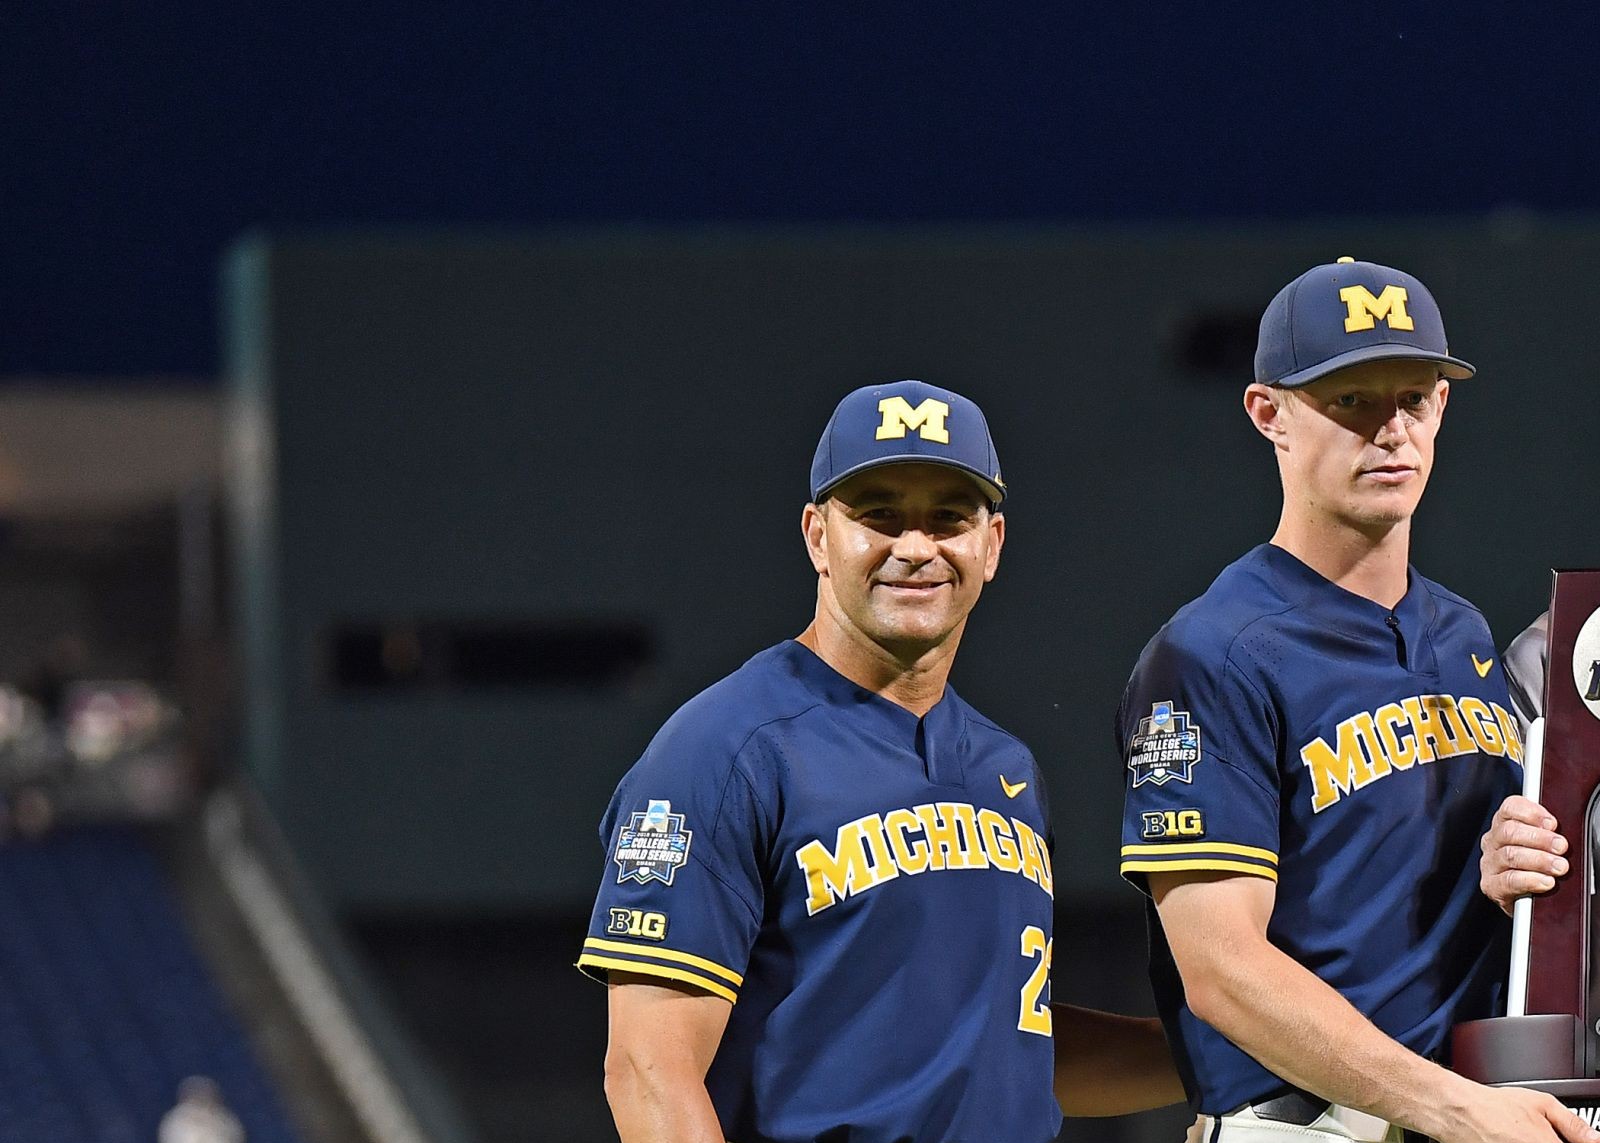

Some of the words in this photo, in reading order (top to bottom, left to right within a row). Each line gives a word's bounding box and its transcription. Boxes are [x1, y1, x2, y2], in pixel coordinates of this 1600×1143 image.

[1340, 284, 1414, 333] M
[875, 396, 949, 443] M
[1142, 738, 1180, 752] COLLEGE
[1300, 694, 1524, 814] MICHIGA
[1131, 752, 1160, 767] WORLD
[1160, 749, 1197, 761] SERIES
[631, 838, 671, 850] COLLEGE
[617, 848, 646, 860] WORLD
[647, 850, 683, 863] SERIES
